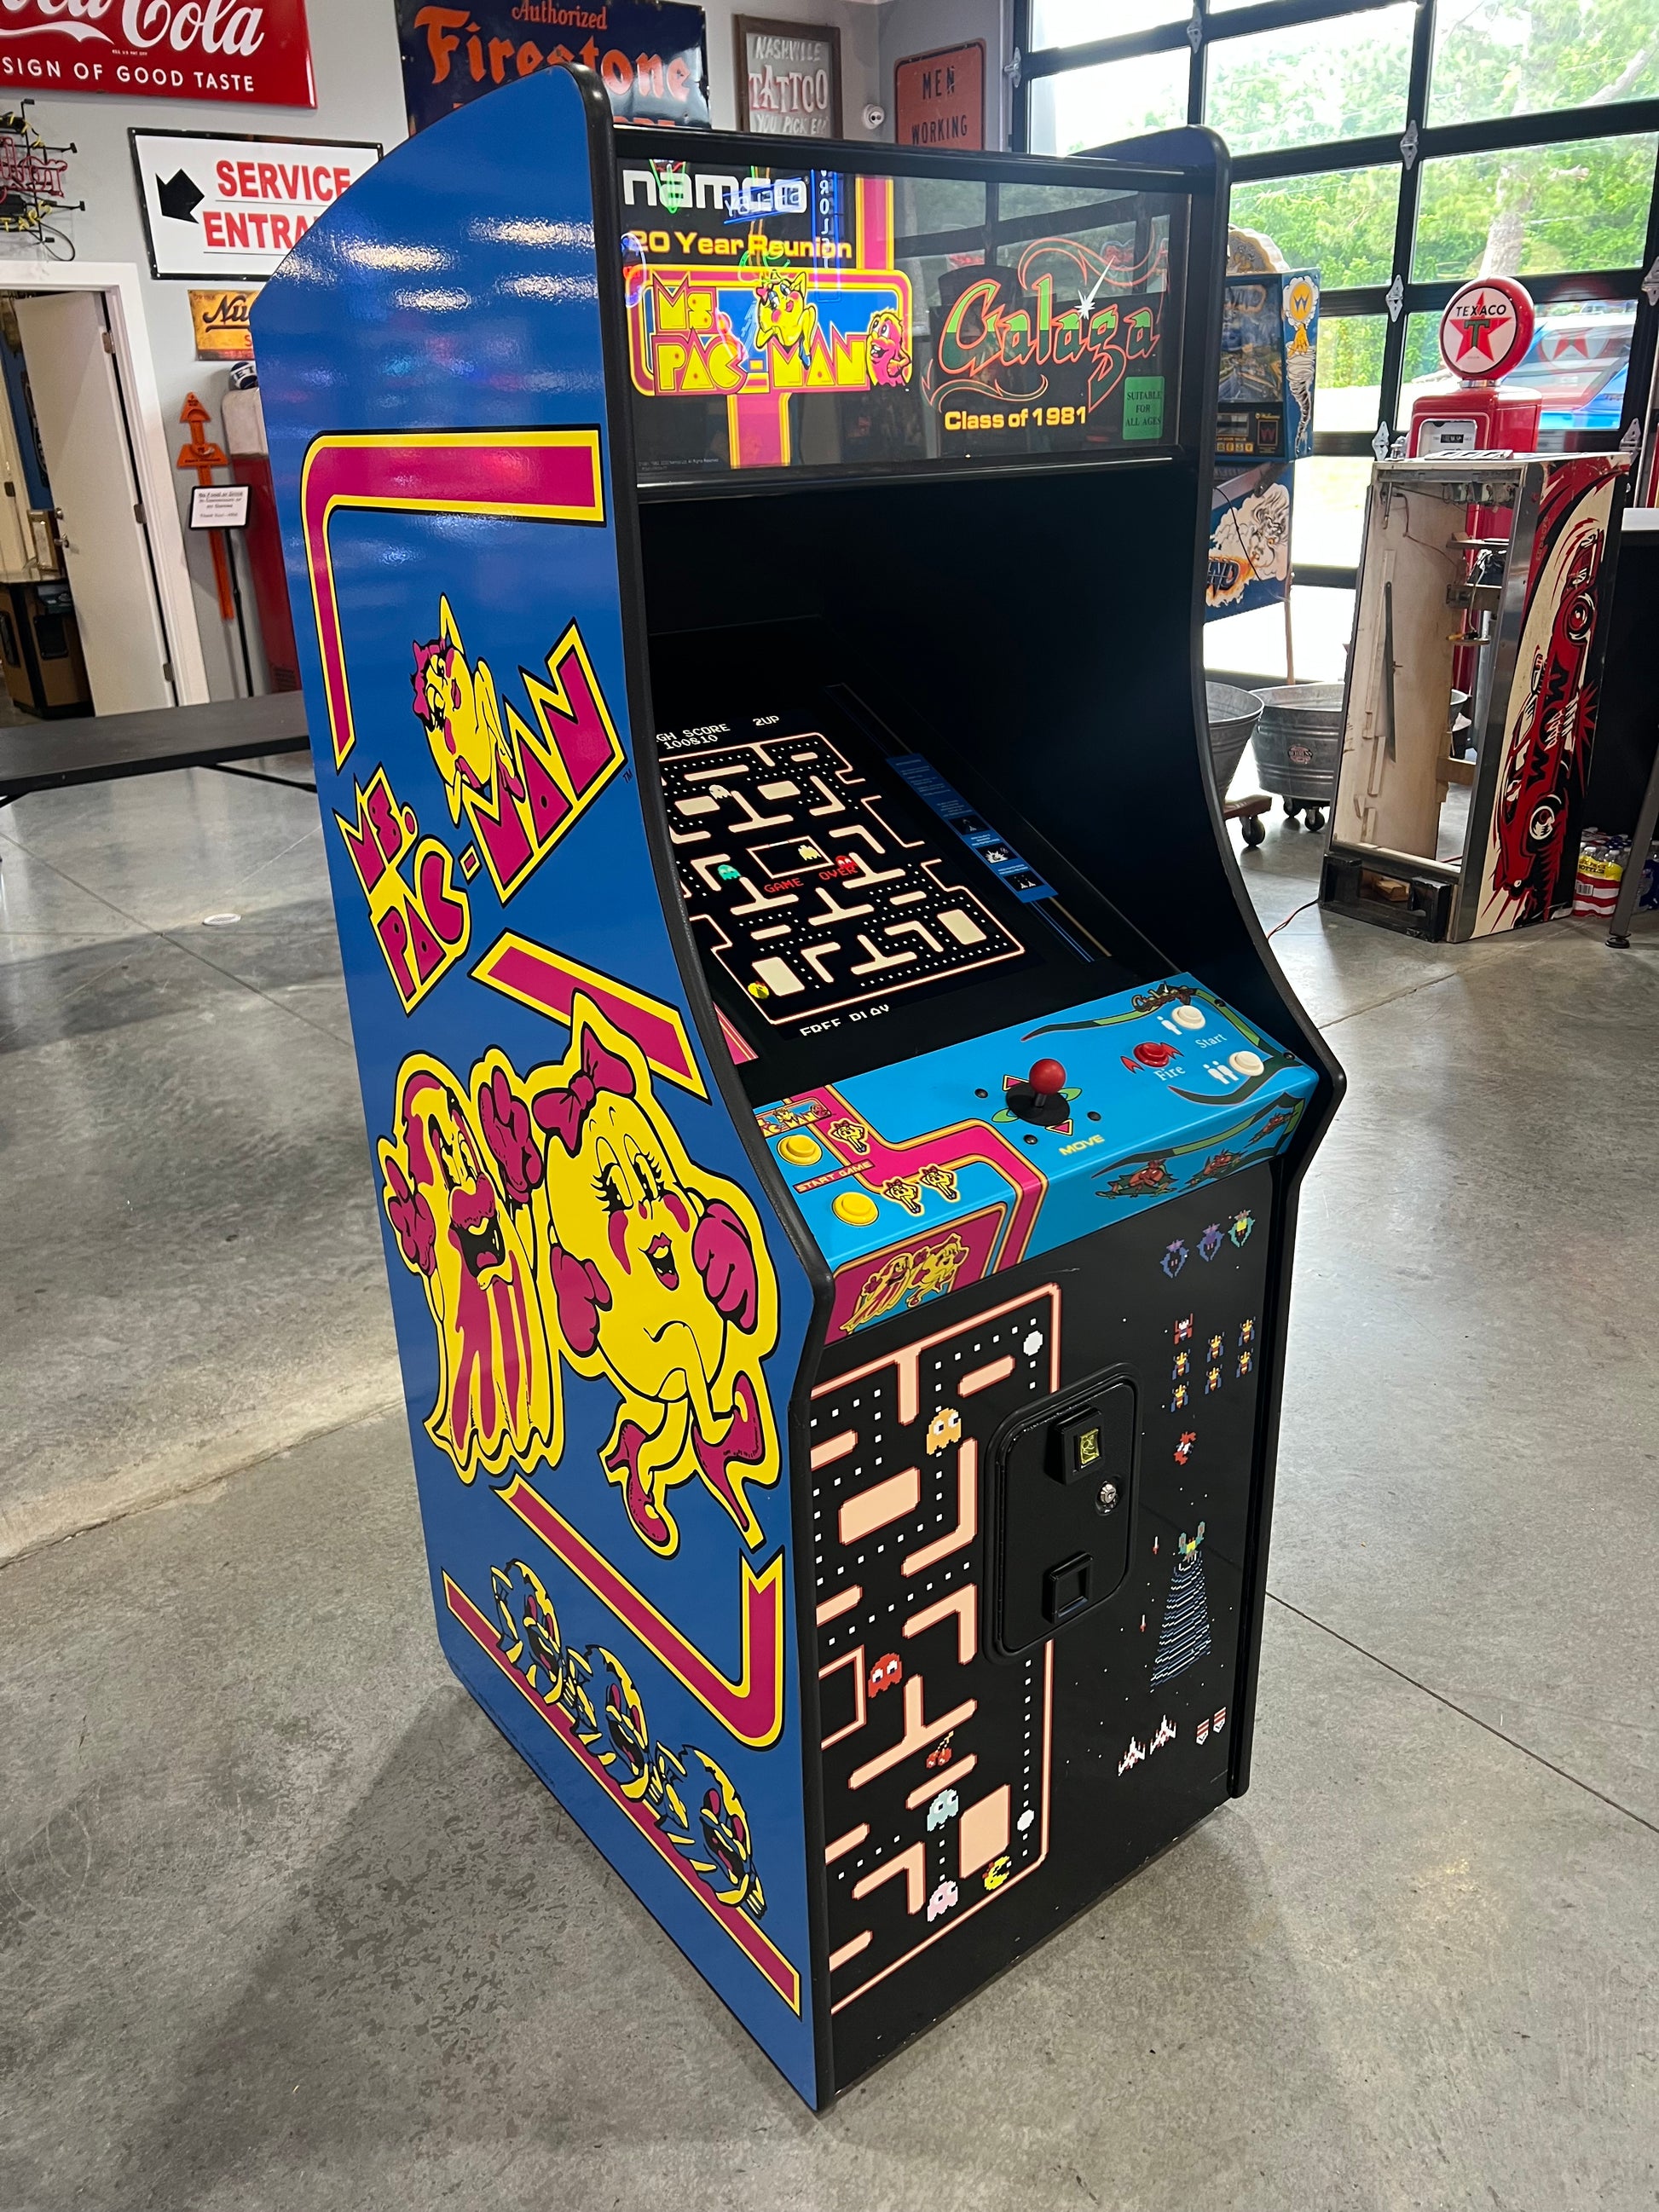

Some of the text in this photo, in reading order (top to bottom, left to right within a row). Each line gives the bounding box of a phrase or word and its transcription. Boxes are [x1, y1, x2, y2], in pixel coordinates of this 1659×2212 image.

[512, 1, 608, 29] Authorized
[755, 37, 823, 61] NASHVILLE
[2, 56, 255, 92] SIGN OF GOOD TASTE
[922, 66, 956, 100] MEN
[749, 65, 829, 113] TATTOO
[911, 115, 968, 145] WORKING
[623, 170, 806, 214] namco
[203, 211, 318, 249] ENTRA
[674, 231, 744, 256] Year
[749, 235, 853, 259] Reunion
[1456, 304, 1506, 317] TEXACO
[939, 273, 1161, 413] Galaga
[654, 335, 868, 393] PAC-MAN
[1127, 390, 1163, 401] SUITABLE
[1136, 404, 1151, 413] FOR
[945, 406, 1087, 430] Class of 1981
[1126, 416, 1162, 426] ALL AGES
[656, 715, 780, 742] GH SCORE 2UP
[373, 627, 624, 1013] PAC-MAN
[764, 866, 858, 893] GAME OVER
[1195, 1034, 1228, 1048] Start
[1153, 1066, 1186, 1081] Fire
[1058, 1135, 1106, 1156] MOVE
[796, 1160, 874, 1193] START GAME
